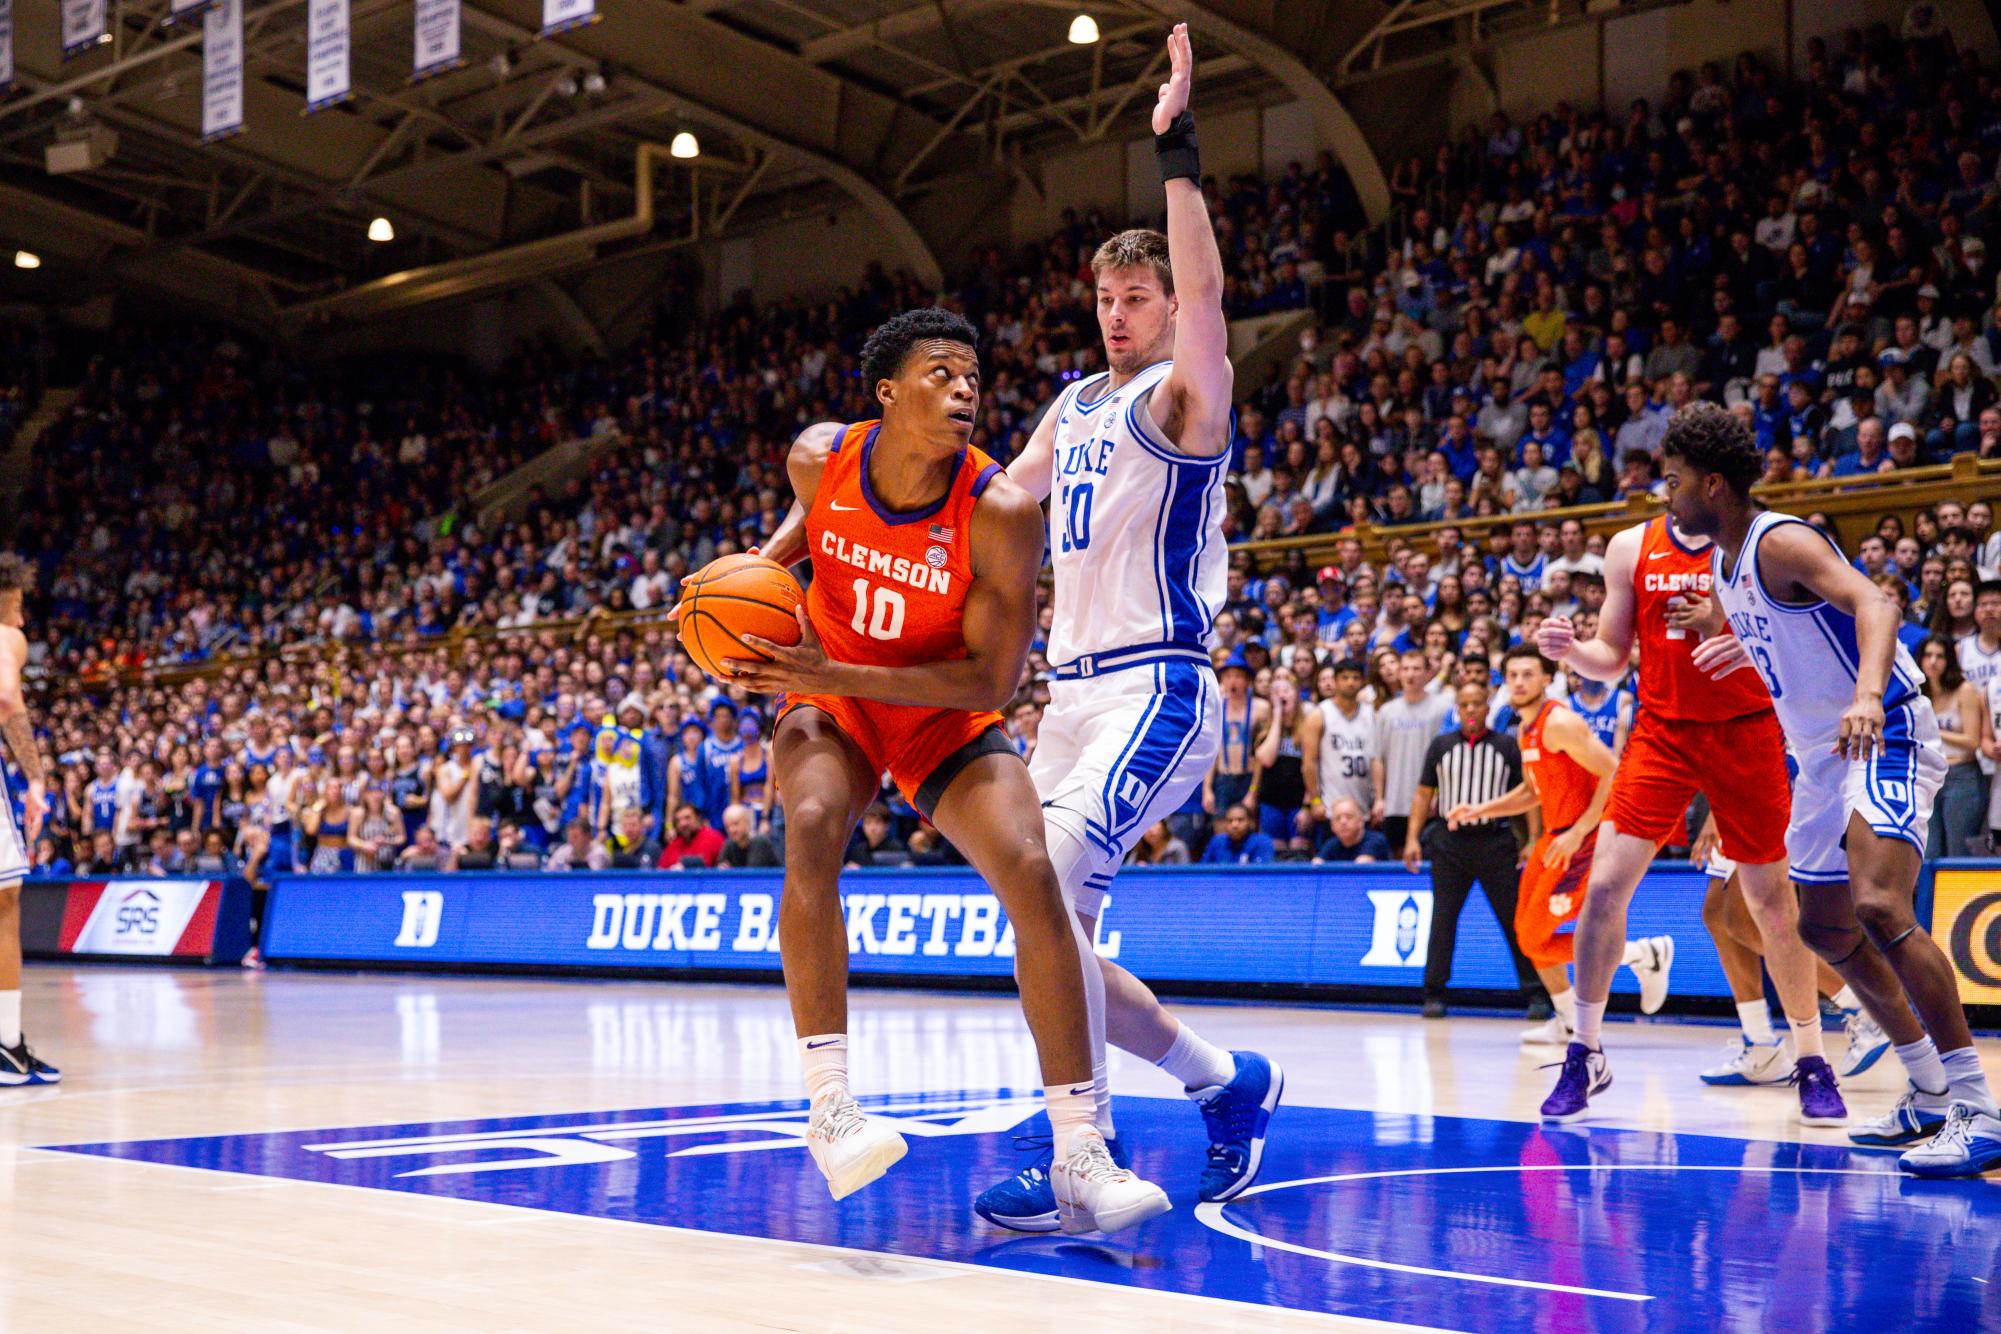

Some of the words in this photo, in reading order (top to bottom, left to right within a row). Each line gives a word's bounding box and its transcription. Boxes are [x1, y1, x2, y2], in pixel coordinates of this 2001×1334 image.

[821, 530, 951, 595] CLEMSON
[1644, 573, 1714, 592] CLEMS
[851, 577, 905, 641] 10
[1341, 755, 1367, 778] 30
[1117, 770, 1148, 809] D
[1879, 779, 1907, 803] D
[116, 907, 159, 933] SRS
[586, 893, 727, 951] DUKE
[732, 893, 1122, 959] BKETBL
